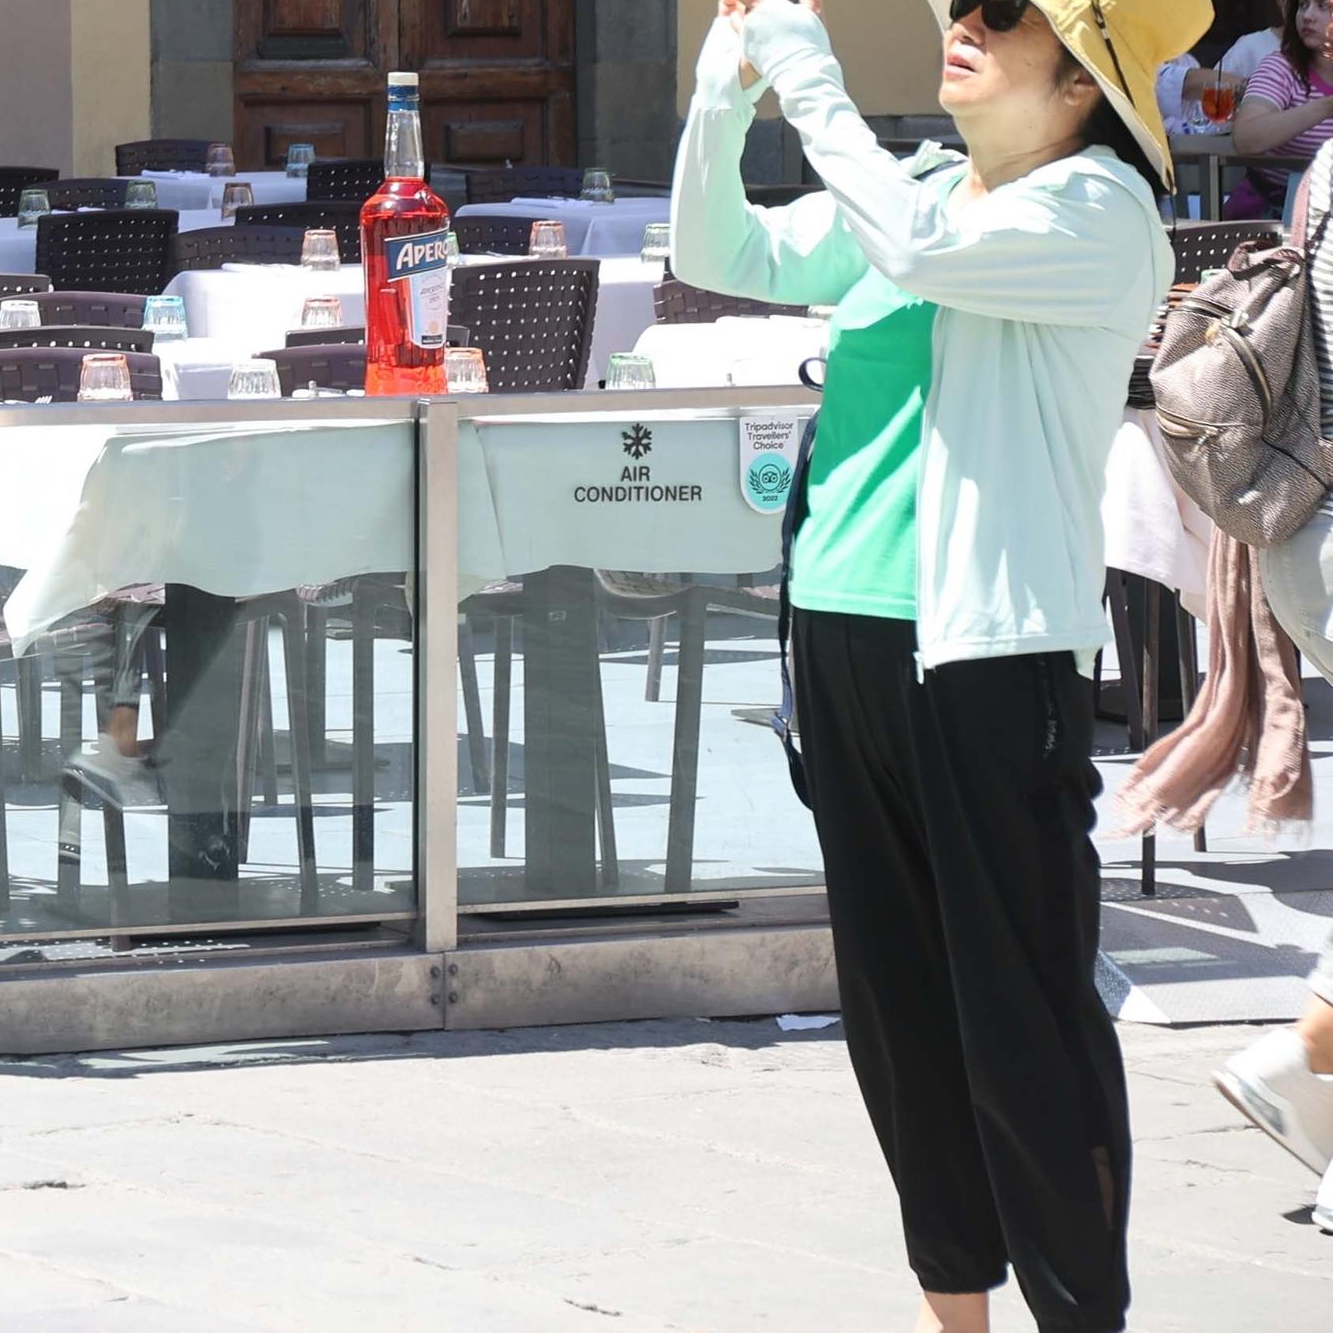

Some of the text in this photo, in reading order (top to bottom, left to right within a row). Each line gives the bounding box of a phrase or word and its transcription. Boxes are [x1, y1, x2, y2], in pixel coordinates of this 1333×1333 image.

[745, 421, 794, 432] Tripadvisor
[747, 431, 791, 441] Travellers'
[753, 441, 784, 450] Choice
[620, 466, 651, 482] AIR
[574, 485, 702, 503] CONDITIONER
